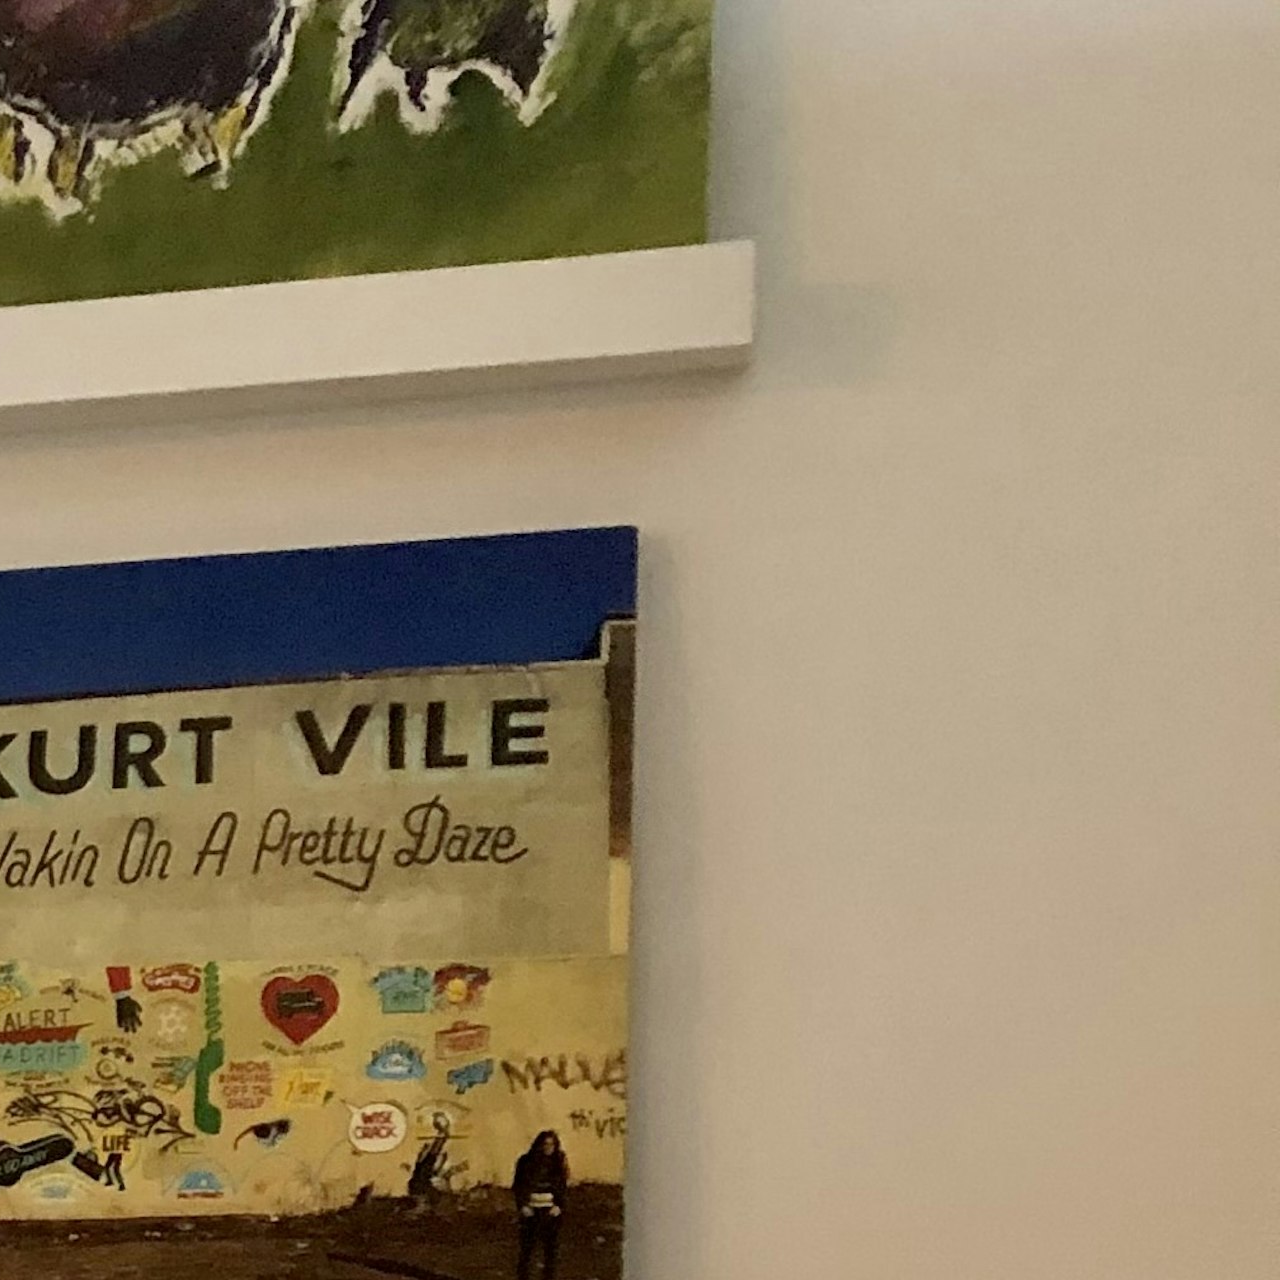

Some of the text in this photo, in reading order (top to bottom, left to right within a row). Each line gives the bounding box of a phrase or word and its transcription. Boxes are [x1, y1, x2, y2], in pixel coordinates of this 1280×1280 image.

[296, 699, 550, 776] VILE
[118, 816, 173, 885] On
[193, 811, 239, 877] A
[252, 808, 386, 892] Pretty
[393, 794, 529, 868] Daze
